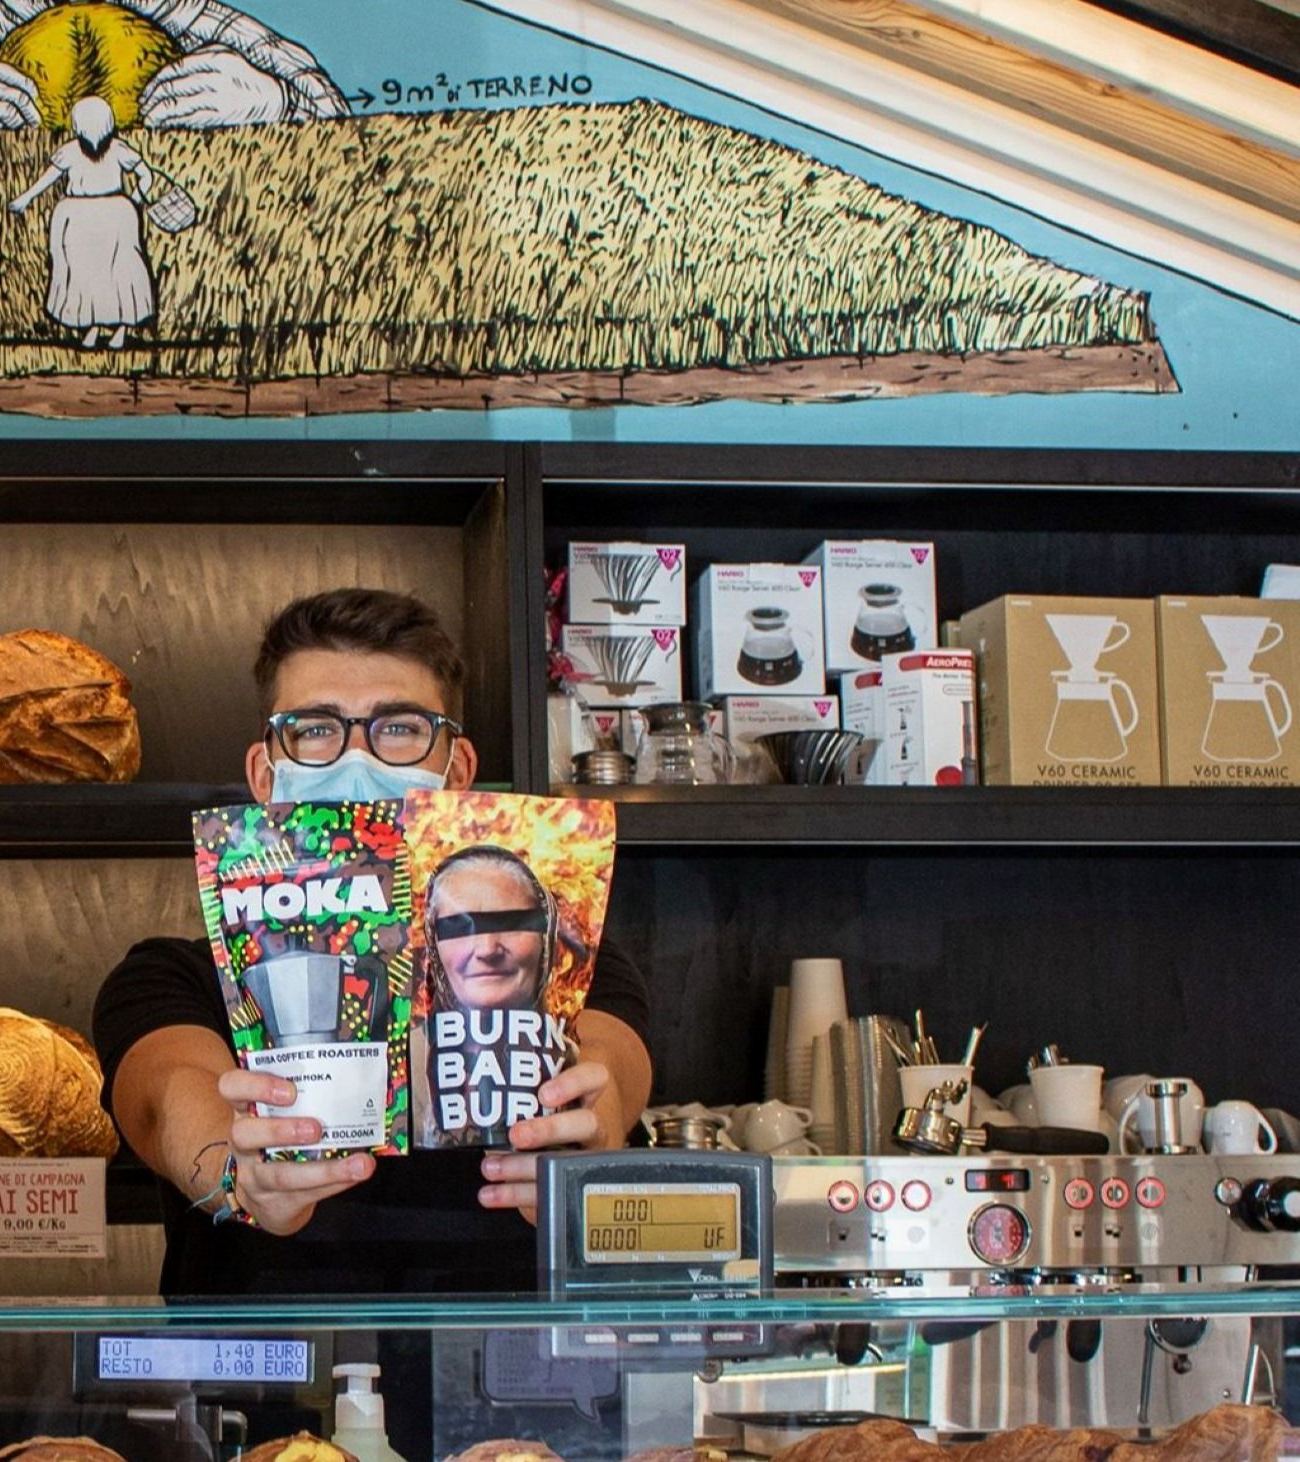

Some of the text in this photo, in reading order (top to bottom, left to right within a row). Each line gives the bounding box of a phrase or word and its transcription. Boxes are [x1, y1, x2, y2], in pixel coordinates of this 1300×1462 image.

[467, 72, 593, 99] TERRENO
[1037, 765, 1136, 779] V60 CERAMIC
[1193, 765, 1289, 780] V60 CERAMIC
[221, 874, 389, 926] MOKA
[435, 1009, 567, 1052] BURN
[277, 1050, 315, 1063] COFFEE
[317, 1047, 379, 1059] ROASTERS
[437, 1049, 566, 1089] BABY
[439, 1090, 557, 1130] BUR
[332, 1129, 375, 1139] BOLOGNA
[14, 1173, 26, 1186] DI
[30, 1173, 86, 1186] CAMPAGNA
[26, 1189, 79, 1214] SEMI
[3, 1218, 34, 1232] 9,00
[102, 1341, 132, 1357] TOT
[264, 1343, 305, 1360] EURO
[101, 1358, 153, 1374] RESTO
[264, 1360, 304, 1376] EURO
